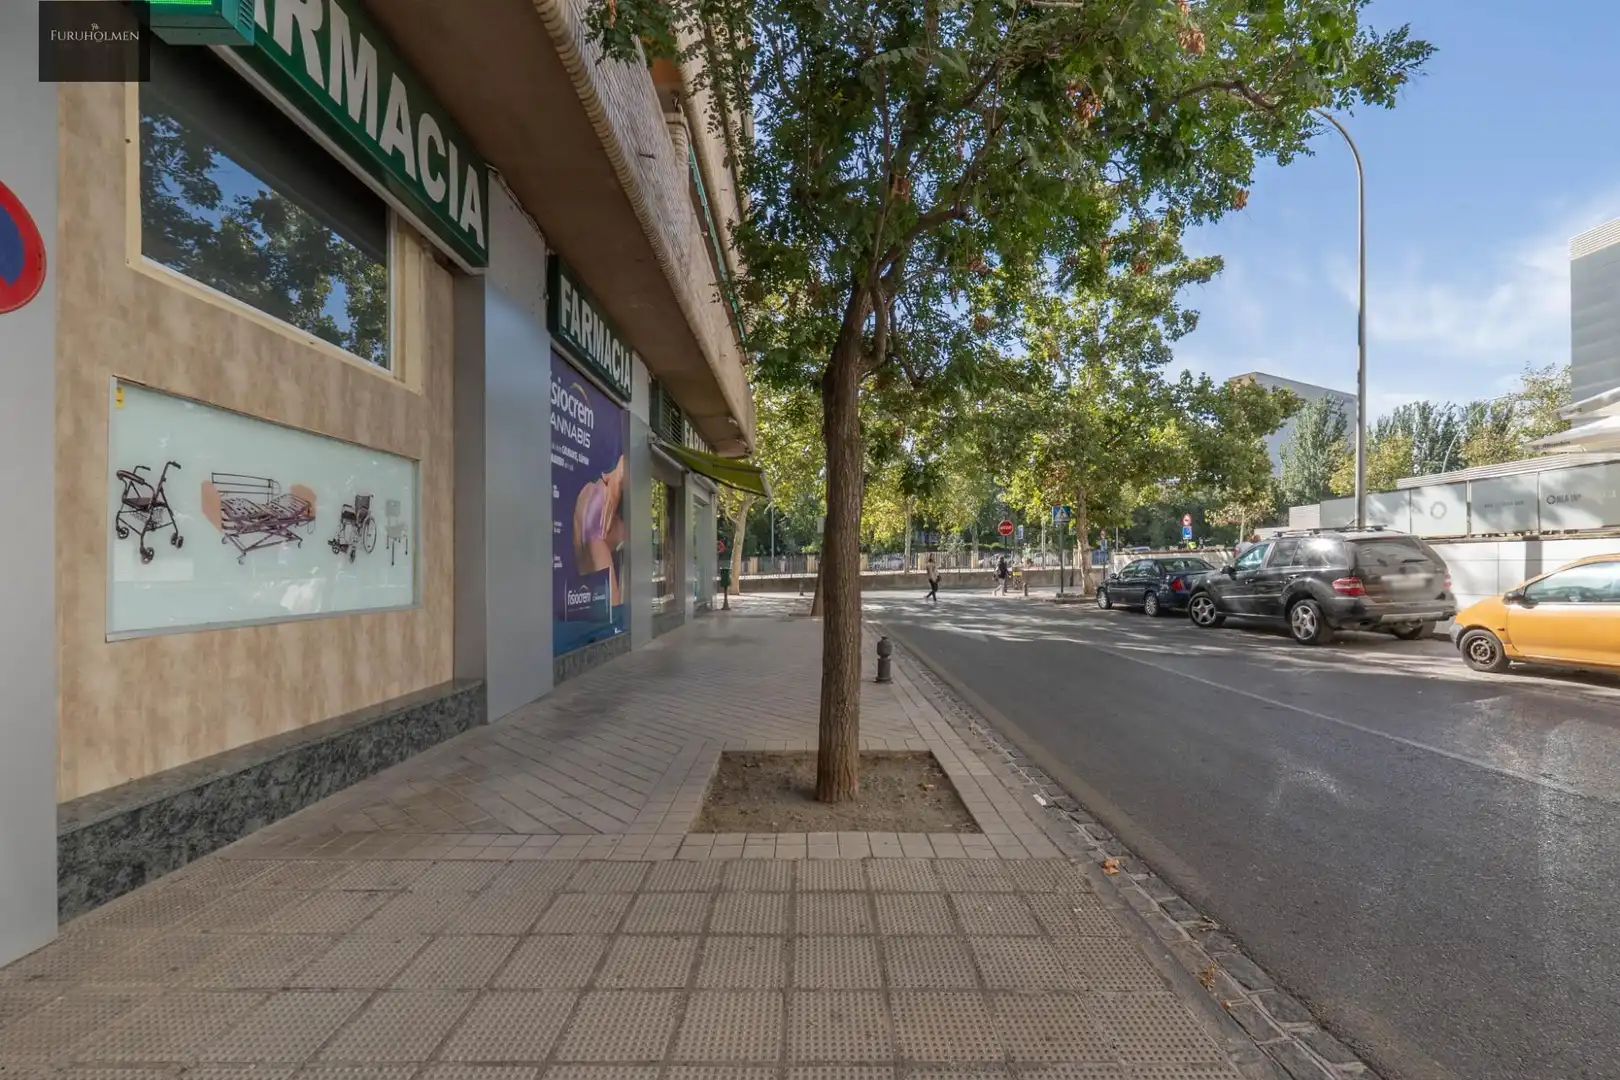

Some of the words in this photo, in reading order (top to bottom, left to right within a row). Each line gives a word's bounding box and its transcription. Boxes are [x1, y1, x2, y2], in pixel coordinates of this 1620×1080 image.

[254, 0, 486, 250] RMACIA
[560, 273, 632, 394] FARMACIA
[550, 377, 595, 430] siocrem
[550, 411, 592, 449] ANNABIS
